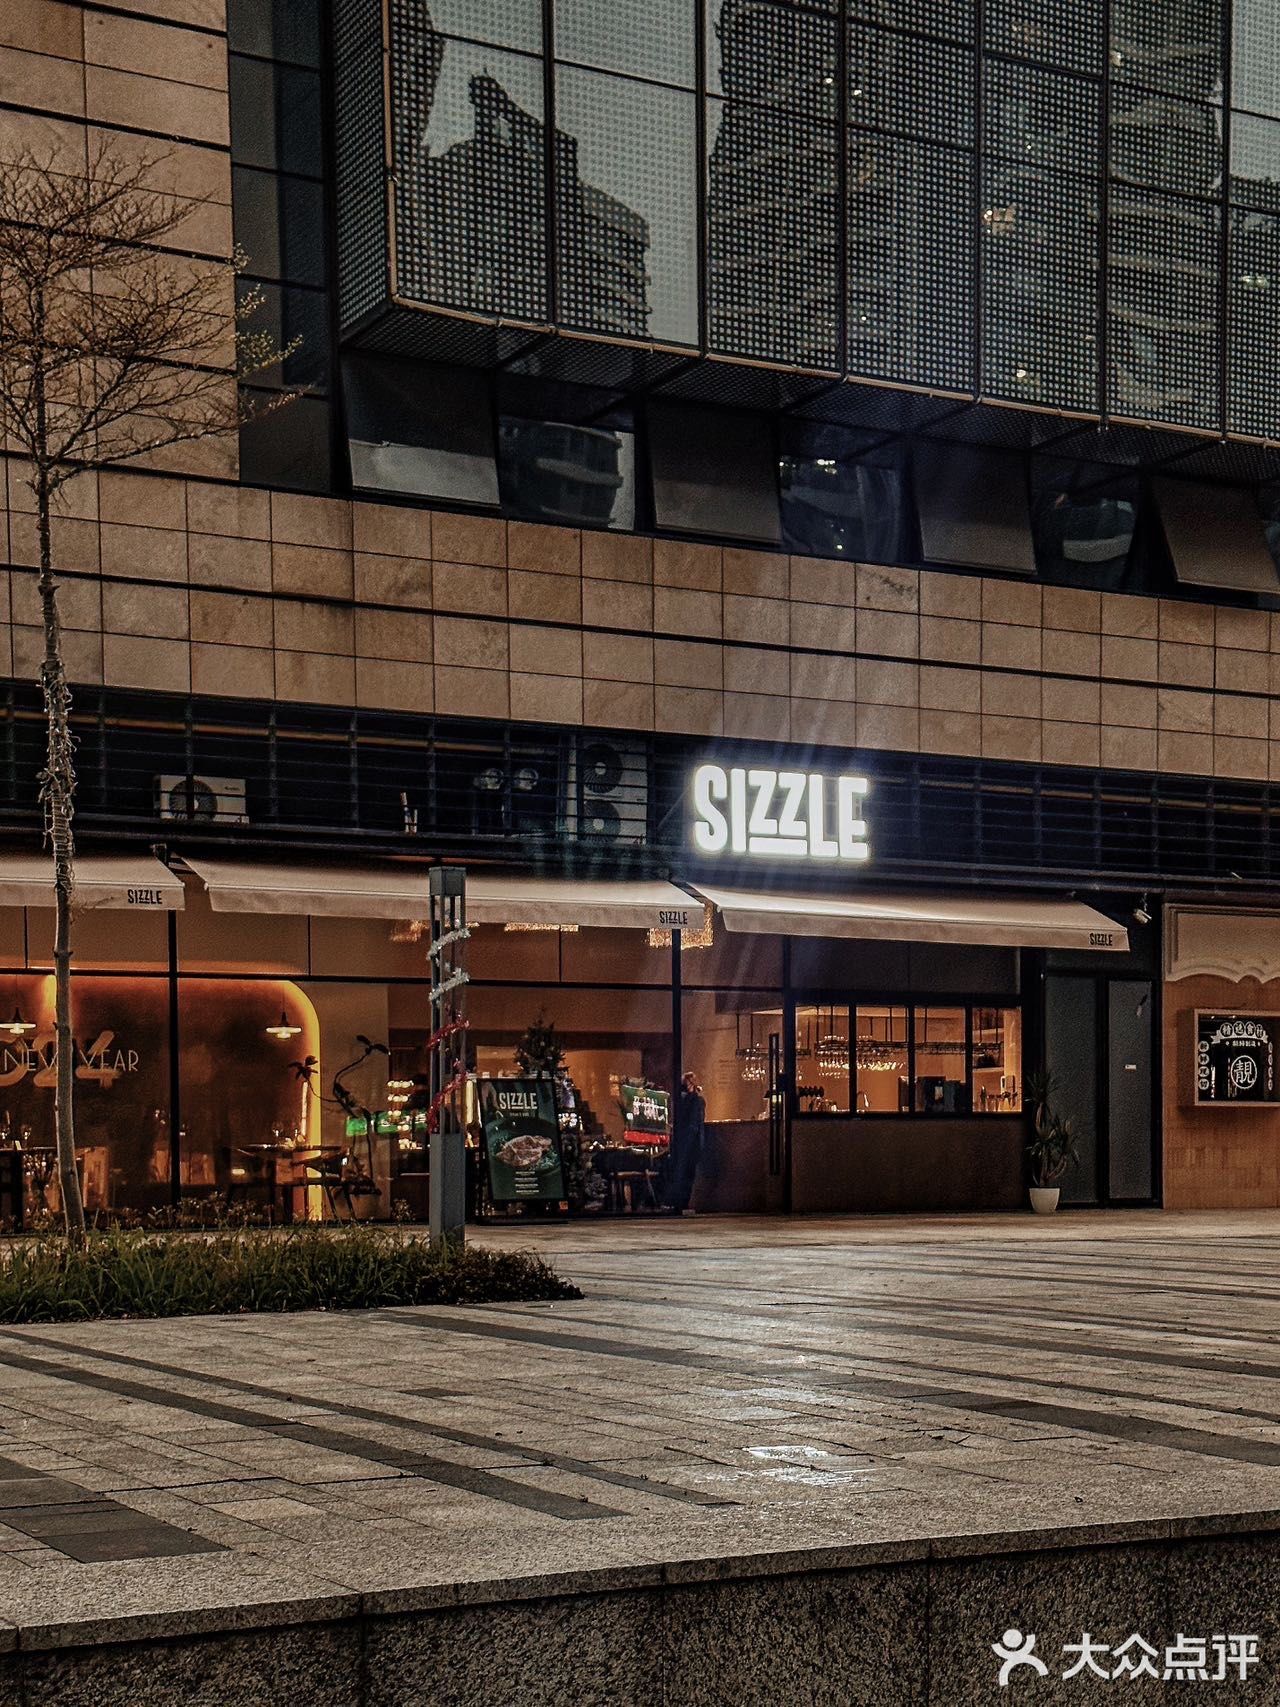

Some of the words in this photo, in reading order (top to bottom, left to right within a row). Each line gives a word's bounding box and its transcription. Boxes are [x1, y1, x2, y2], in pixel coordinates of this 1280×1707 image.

[694, 765, 868, 858] SIZZLE
[127, 889, 163, 905] SIZZLE
[659, 910, 688, 925] SIZZLE
[1089, 932, 1113, 947] SIZZLE
[79, 1049, 140, 1072] YEAR
[1232, 1059, 1256, 1084] 靚
[499, 1092, 538, 1110] SIZZLE
